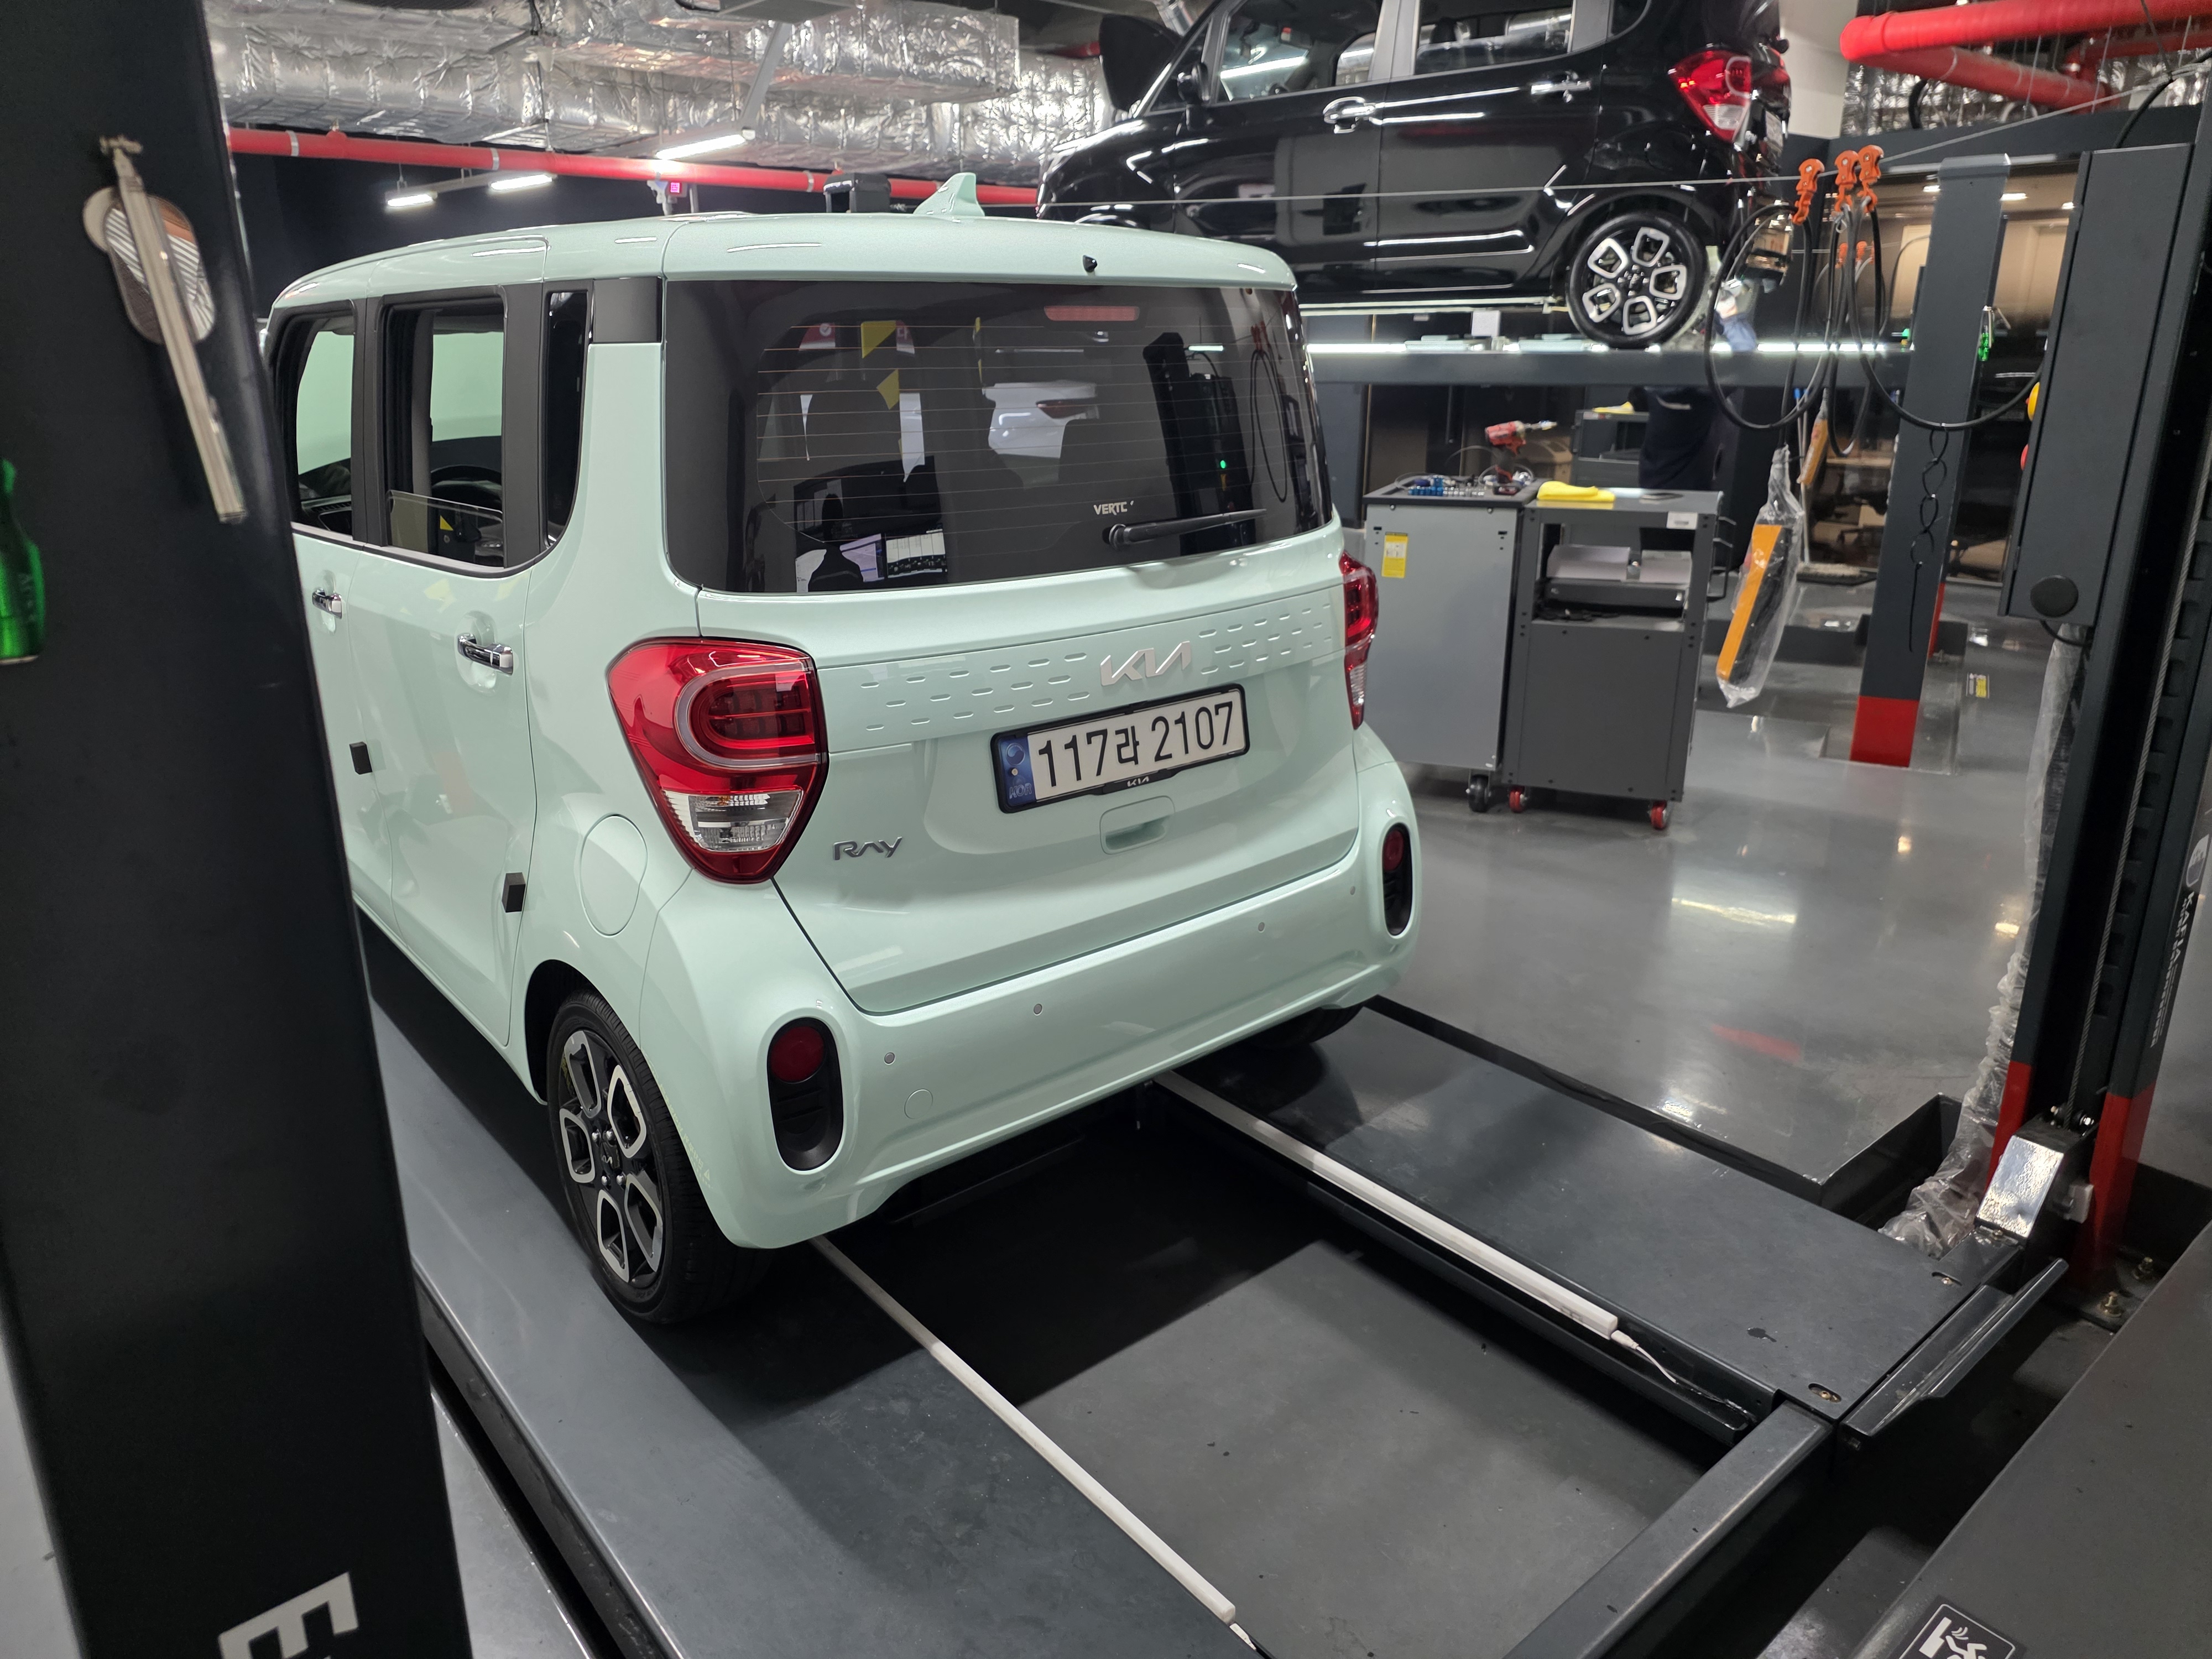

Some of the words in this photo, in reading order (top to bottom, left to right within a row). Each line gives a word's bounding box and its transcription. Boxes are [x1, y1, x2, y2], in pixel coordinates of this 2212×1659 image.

[1100, 640, 1191, 686] KIA
[1038, 726, 1140, 787] 117라
[1151, 701, 1233, 763] 2107
[1009, 782, 1032, 799] KOR
[1127, 776, 1149, 787] KIA
[833, 836, 902, 860] RAY
